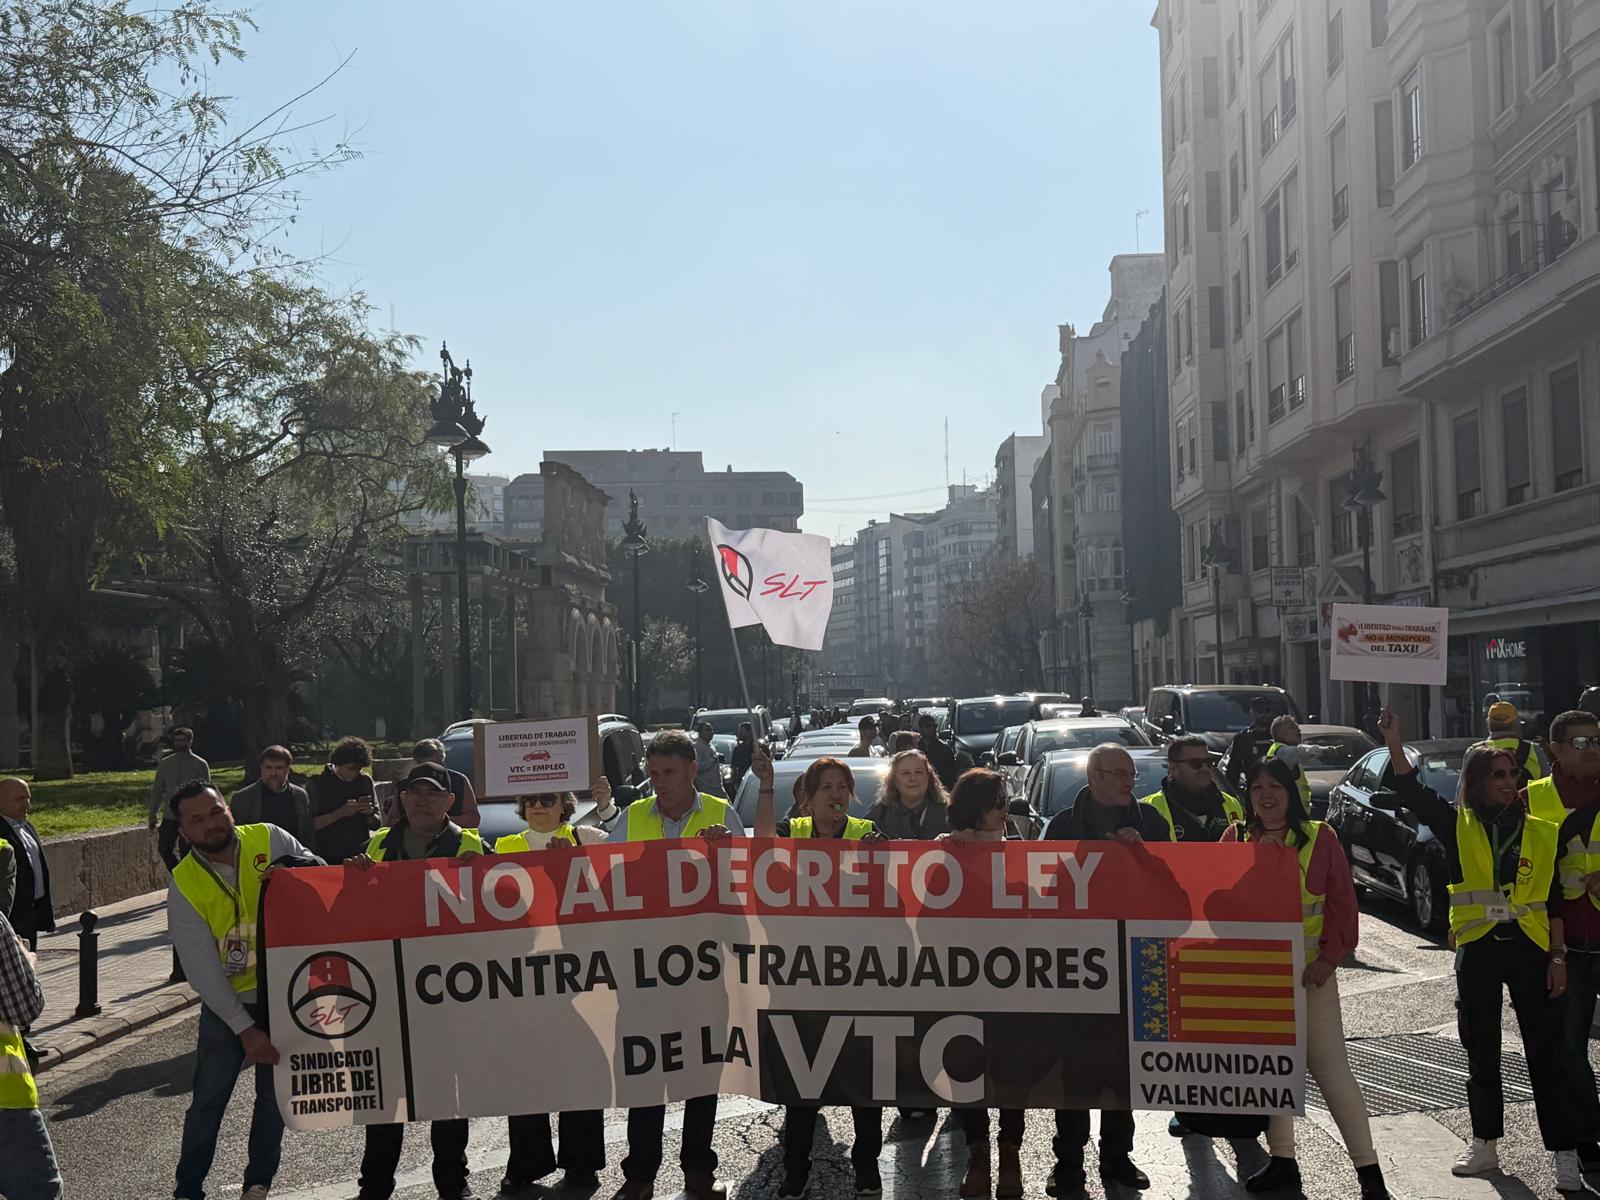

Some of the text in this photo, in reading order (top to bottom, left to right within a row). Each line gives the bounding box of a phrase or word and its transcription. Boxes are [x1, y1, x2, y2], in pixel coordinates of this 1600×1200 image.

[760, 573, 827, 600] SLT
[1387, 644, 1419, 653] TAXI!
[498, 730, 576, 742] LIBERTAD DE TRABAJO
[498, 738, 577, 749] LIBERTAD DE MOVIMIENTO
[510, 765, 526, 773] VTC
[532, 763, 565, 772] EMPLEO
[424, 847, 1104, 927] NO AL DECRETO LEY
[415, 940, 1109, 1005] CONTRA LOS TRABAJADORES
[310, 1002, 360, 1028] SLT
[290, 1049, 374, 1071] SINDICATO
[623, 1014, 986, 1103] DE LA VTC
[1140, 1051, 1294, 1076] COMUNIDAD
[291, 1069, 375, 1096] LIBRE DE
[291, 1095, 377, 1115] TRANSPORTE
[1140, 1083, 1296, 1109] VALENCIANA
